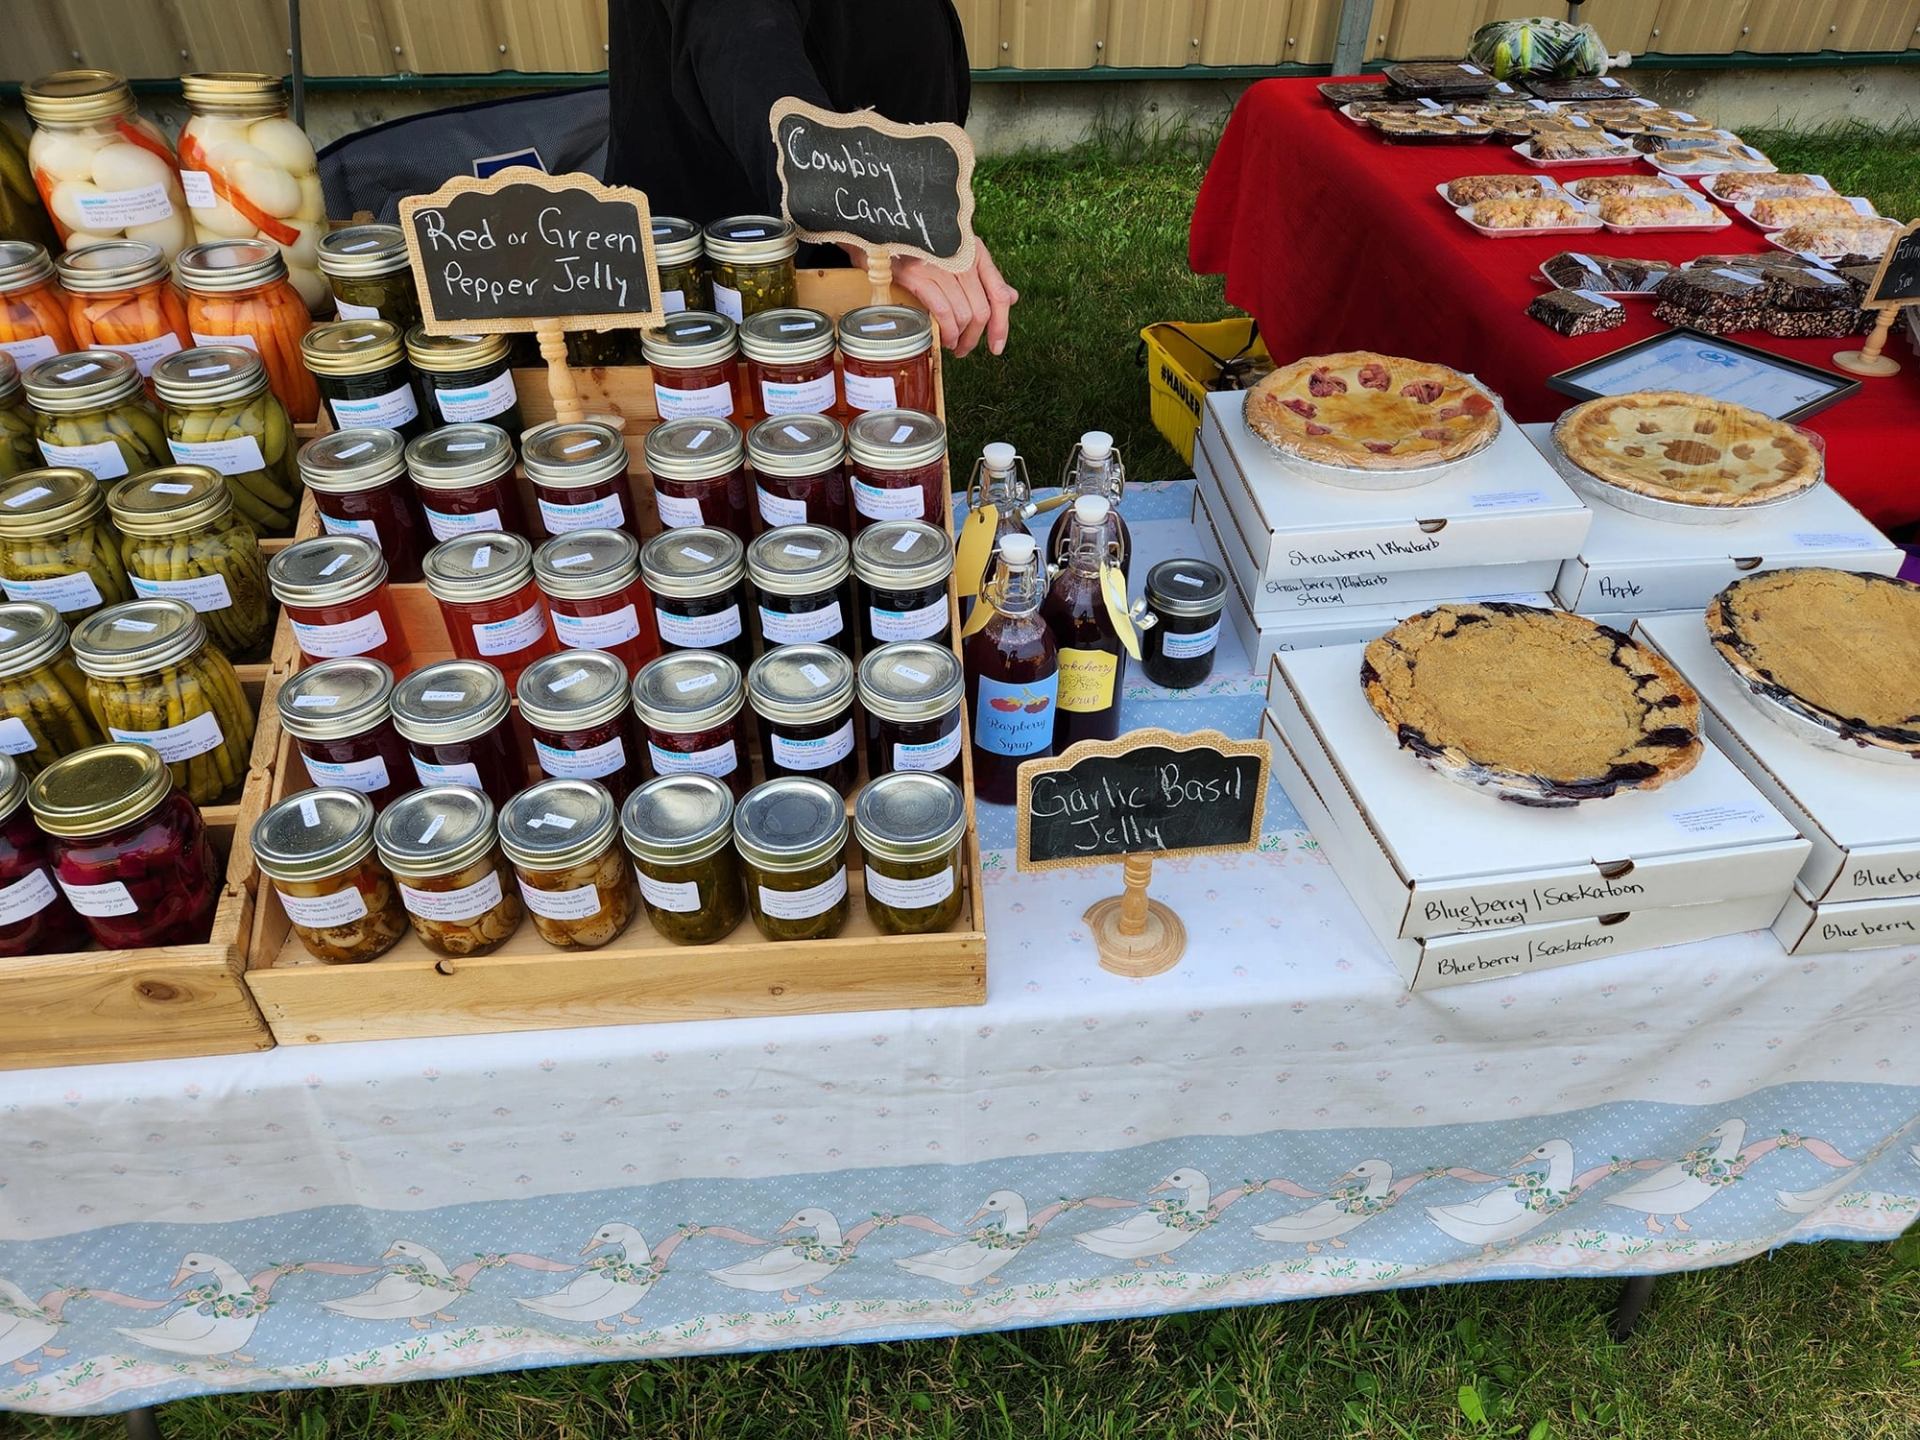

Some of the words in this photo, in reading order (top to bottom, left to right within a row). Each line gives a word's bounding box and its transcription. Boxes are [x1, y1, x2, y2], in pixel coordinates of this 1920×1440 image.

[787, 126, 903, 200] Cowboy
[414, 209, 497, 251] Red
[507, 230, 529, 246] or
[538, 207, 637, 254] Green
[835, 187, 935, 252] Candy
[443, 260, 540, 305] Pepper
[552, 255, 628, 307] Jelly
[1288, 548, 1377, 567] Strawberry
[1265, 577, 1334, 594] Strawberry
[1296, 593, 1345, 607] Strusel
[1599, 576, 1644, 599] Apple
[987, 717, 1046, 735] Raspberry
[998, 737, 1033, 752] Syrup
[1030, 777, 1146, 816] Garlic
[1160, 763, 1241, 807] Basil
[1071, 814, 1167, 851] Jelly
[1425, 896, 1528, 921] Blueberry
[1543, 880, 1645, 906] Saskatoon
[1457, 911, 1527, 932] Strusel
[1823, 921, 1916, 940] Blueberry
[1438, 954, 1520, 976] Blueberry
[1535, 934, 1614, 958] Saskatoon
